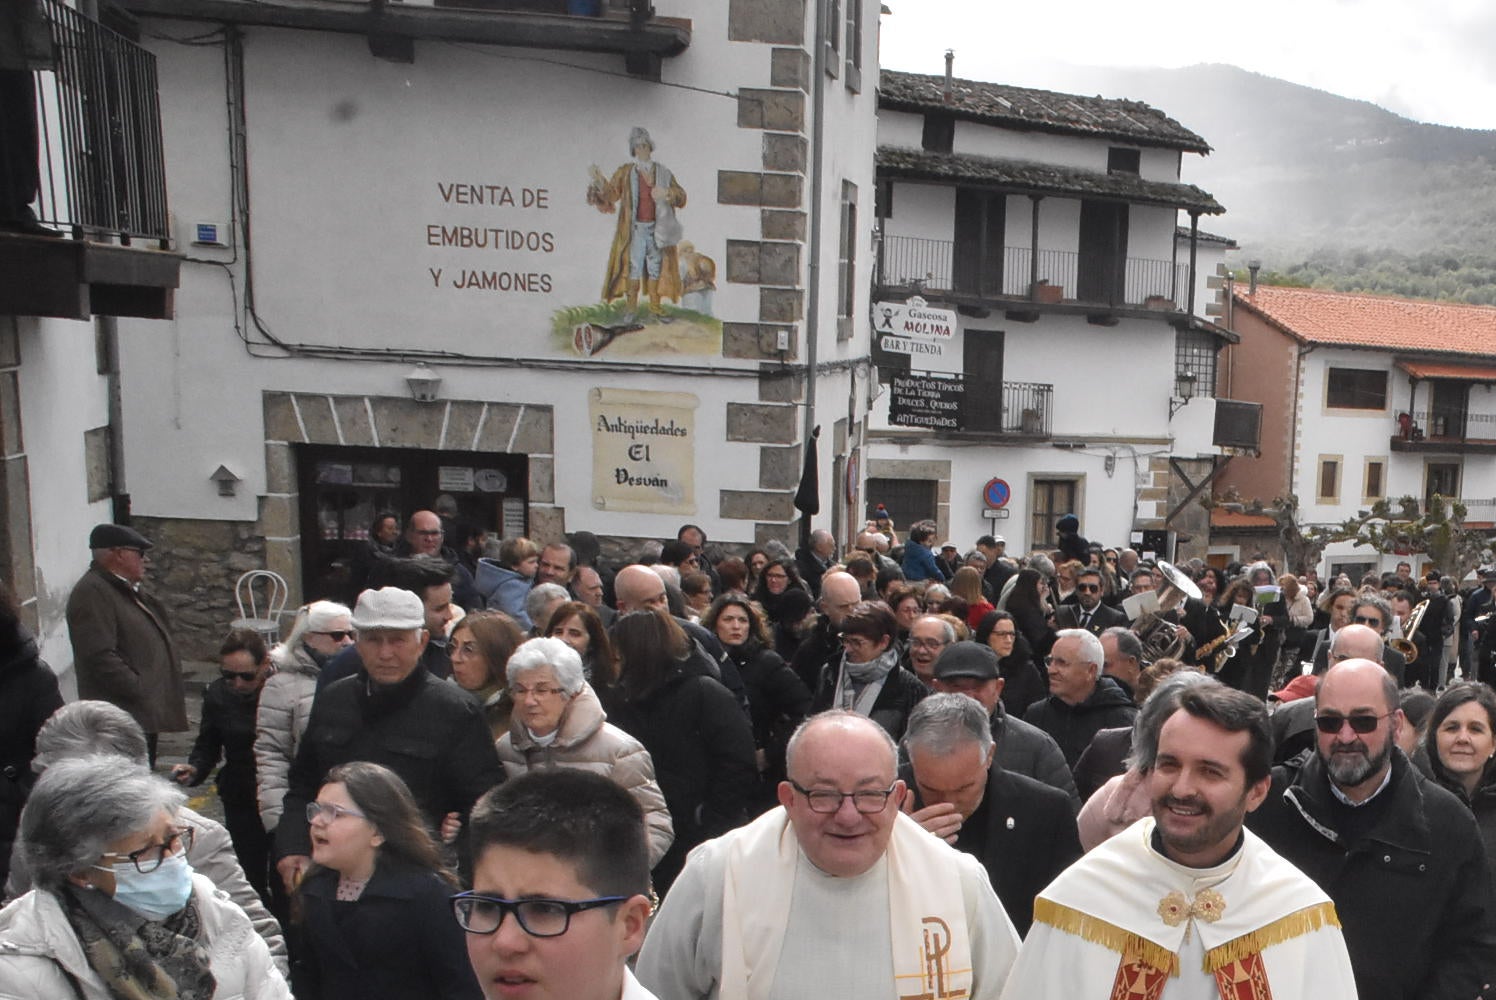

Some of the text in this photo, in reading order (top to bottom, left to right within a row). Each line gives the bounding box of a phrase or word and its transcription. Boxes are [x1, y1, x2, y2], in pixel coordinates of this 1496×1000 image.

[438, 182, 549, 209] VENTA DE
[427, 225, 554, 252] EMBUTIDOS
[430, 268, 552, 293] Y JAMONES
[908, 309, 947, 321] Gaseosa
[904, 321, 950, 336] MOLINA
[884, 338, 942, 356] BAR Y TIENDA
[597, 414, 687, 440] Antigüedades
[628, 443, 651, 462] El
